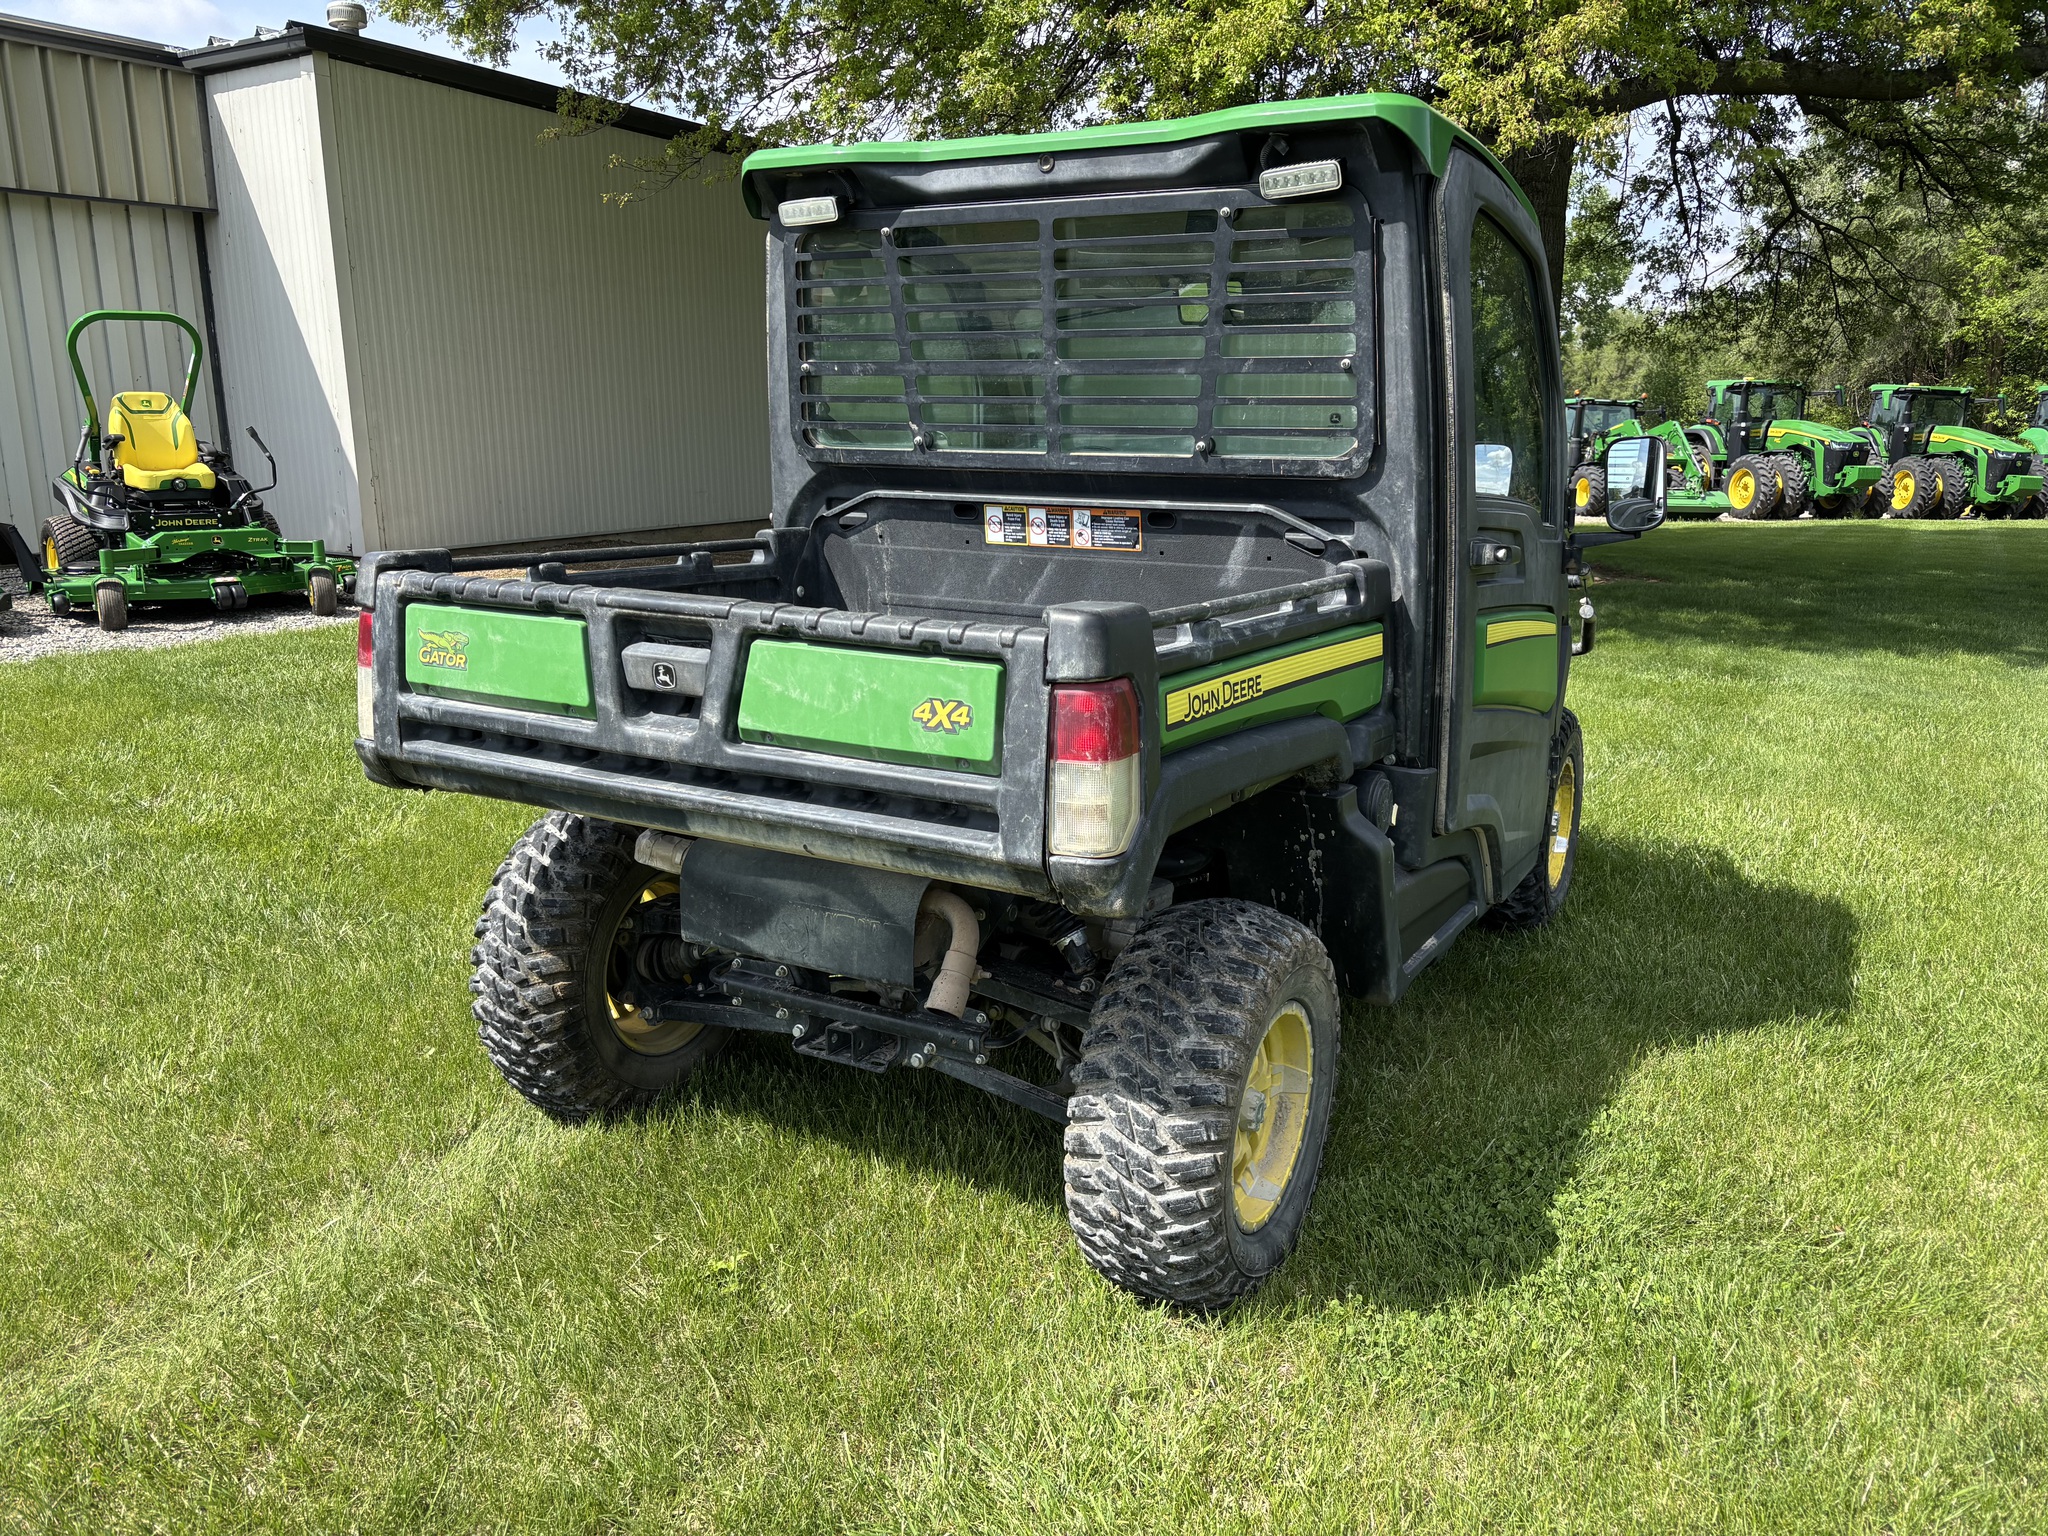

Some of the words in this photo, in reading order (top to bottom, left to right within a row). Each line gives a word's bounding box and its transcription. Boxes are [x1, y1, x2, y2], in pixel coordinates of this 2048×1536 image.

[155, 519, 183, 527] JOHN
[185, 518, 218, 526] DEERE
[419, 646, 467, 668] GATOR
[1184, 688, 1221, 720] JOHN
[1222, 674, 1263, 705] DEERE
[912, 699, 971, 730] 4X4
